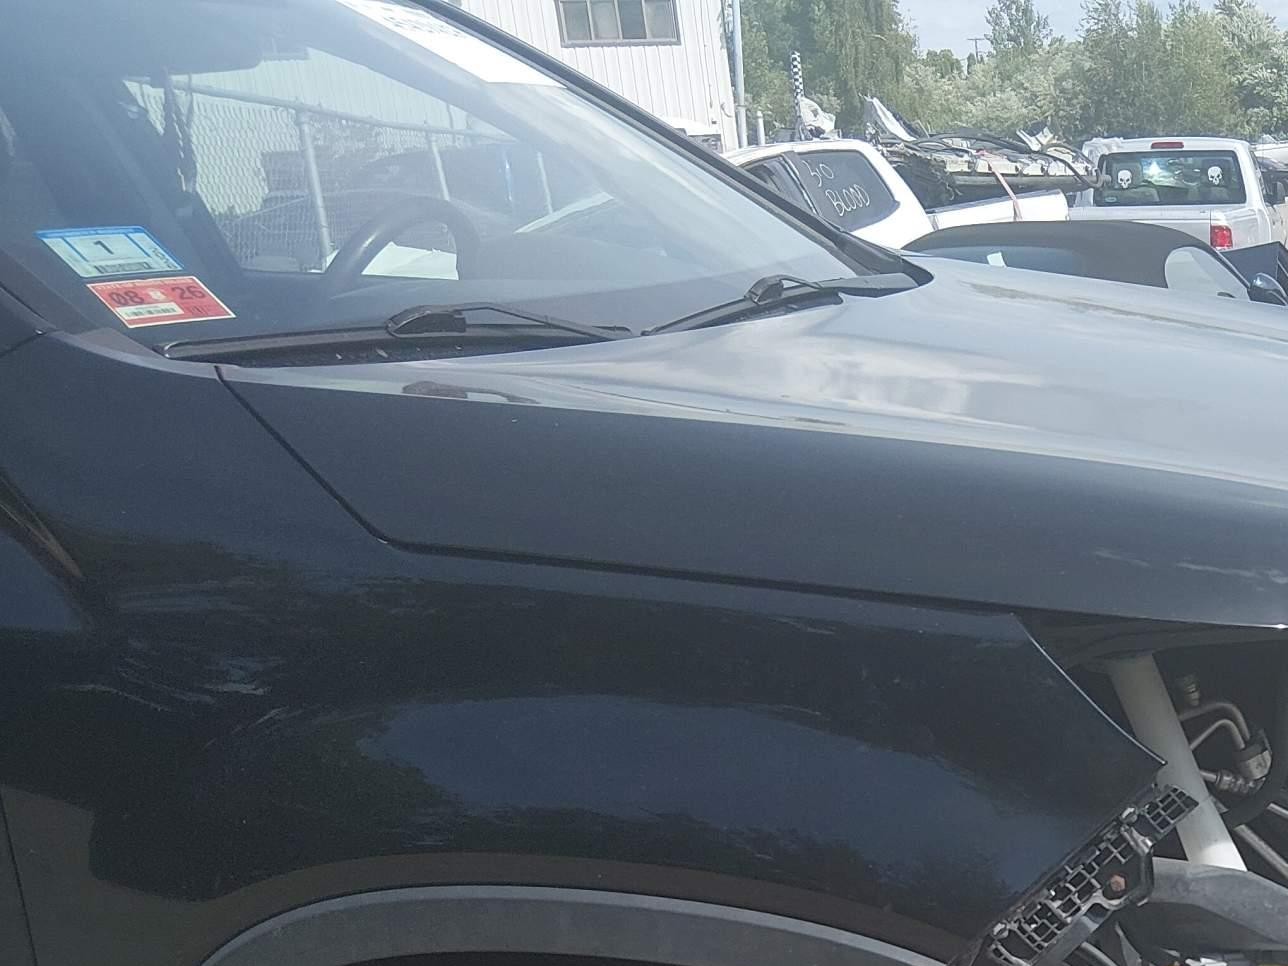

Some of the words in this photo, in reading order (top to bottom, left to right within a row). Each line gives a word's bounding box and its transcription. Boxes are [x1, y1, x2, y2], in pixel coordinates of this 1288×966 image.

[825, 184, 870, 216] BLOOD
[94, 240, 114, 255] 1
[108, 290, 145, 307] 08
[171, 285, 206, 300] 26
